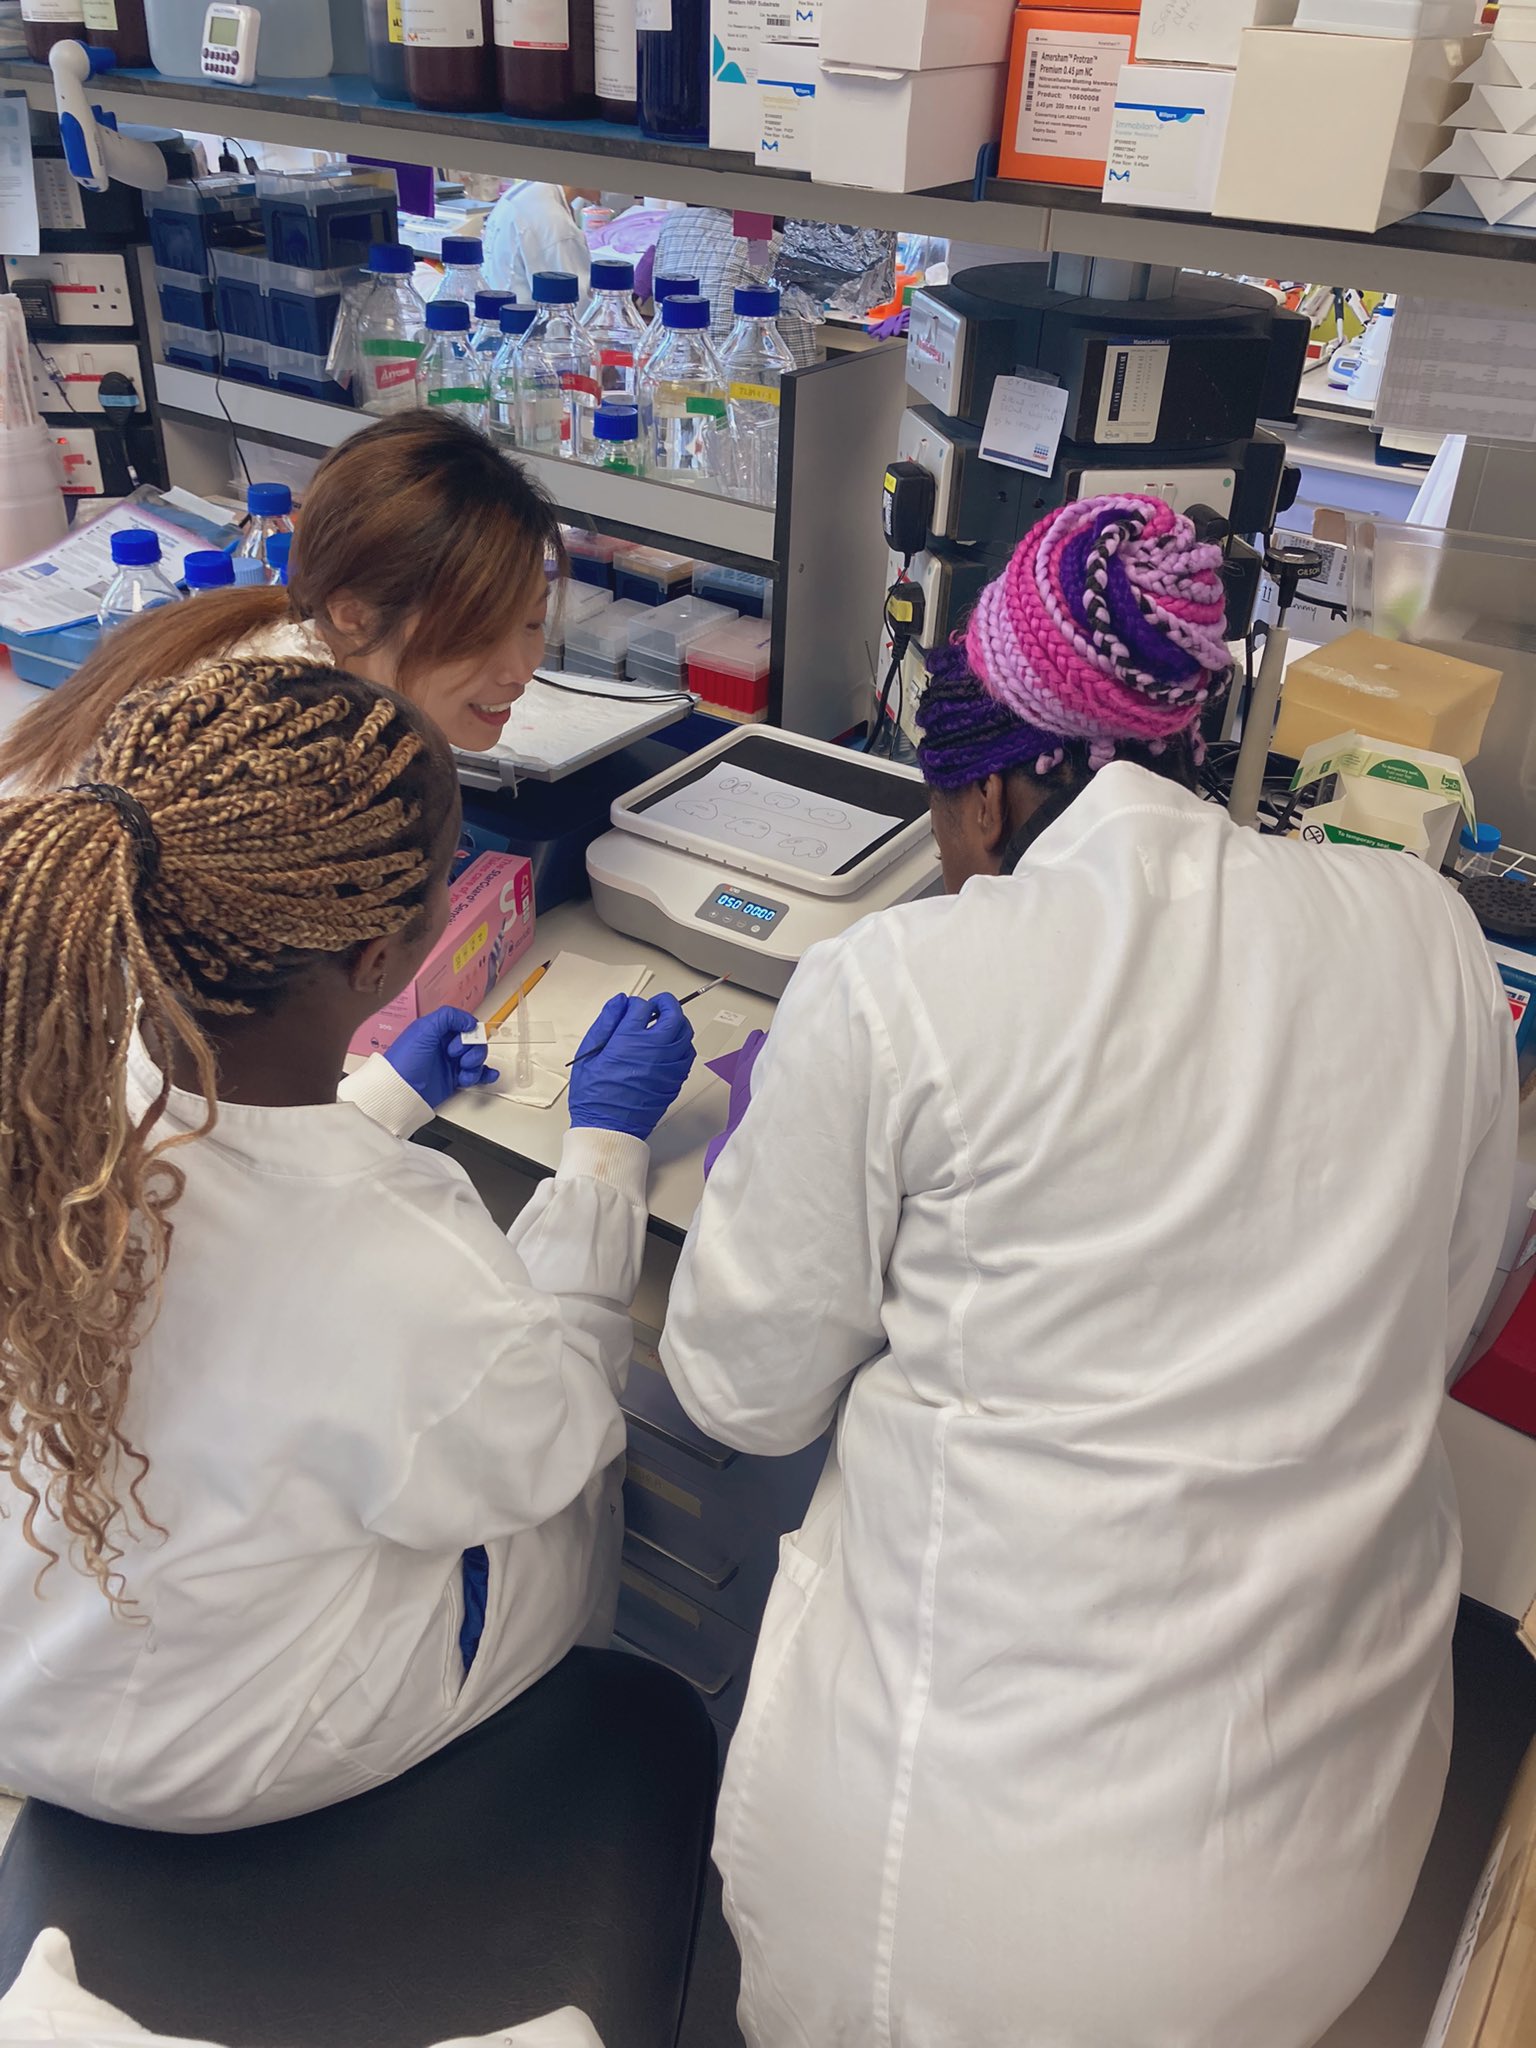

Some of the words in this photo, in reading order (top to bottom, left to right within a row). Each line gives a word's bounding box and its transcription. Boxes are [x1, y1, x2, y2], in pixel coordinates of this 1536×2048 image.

[1040, 64, 1063, 74] Premium
[1063, 66, 1075, 75] 0.45
[1085, 68, 1093, 76] NC
[1037, 91, 1062, 99] Product:
[1069, 93, 1099, 101] 10600008
[1346, 833, 1375, 847] temporary
[718, 895, 742, 910] 050
